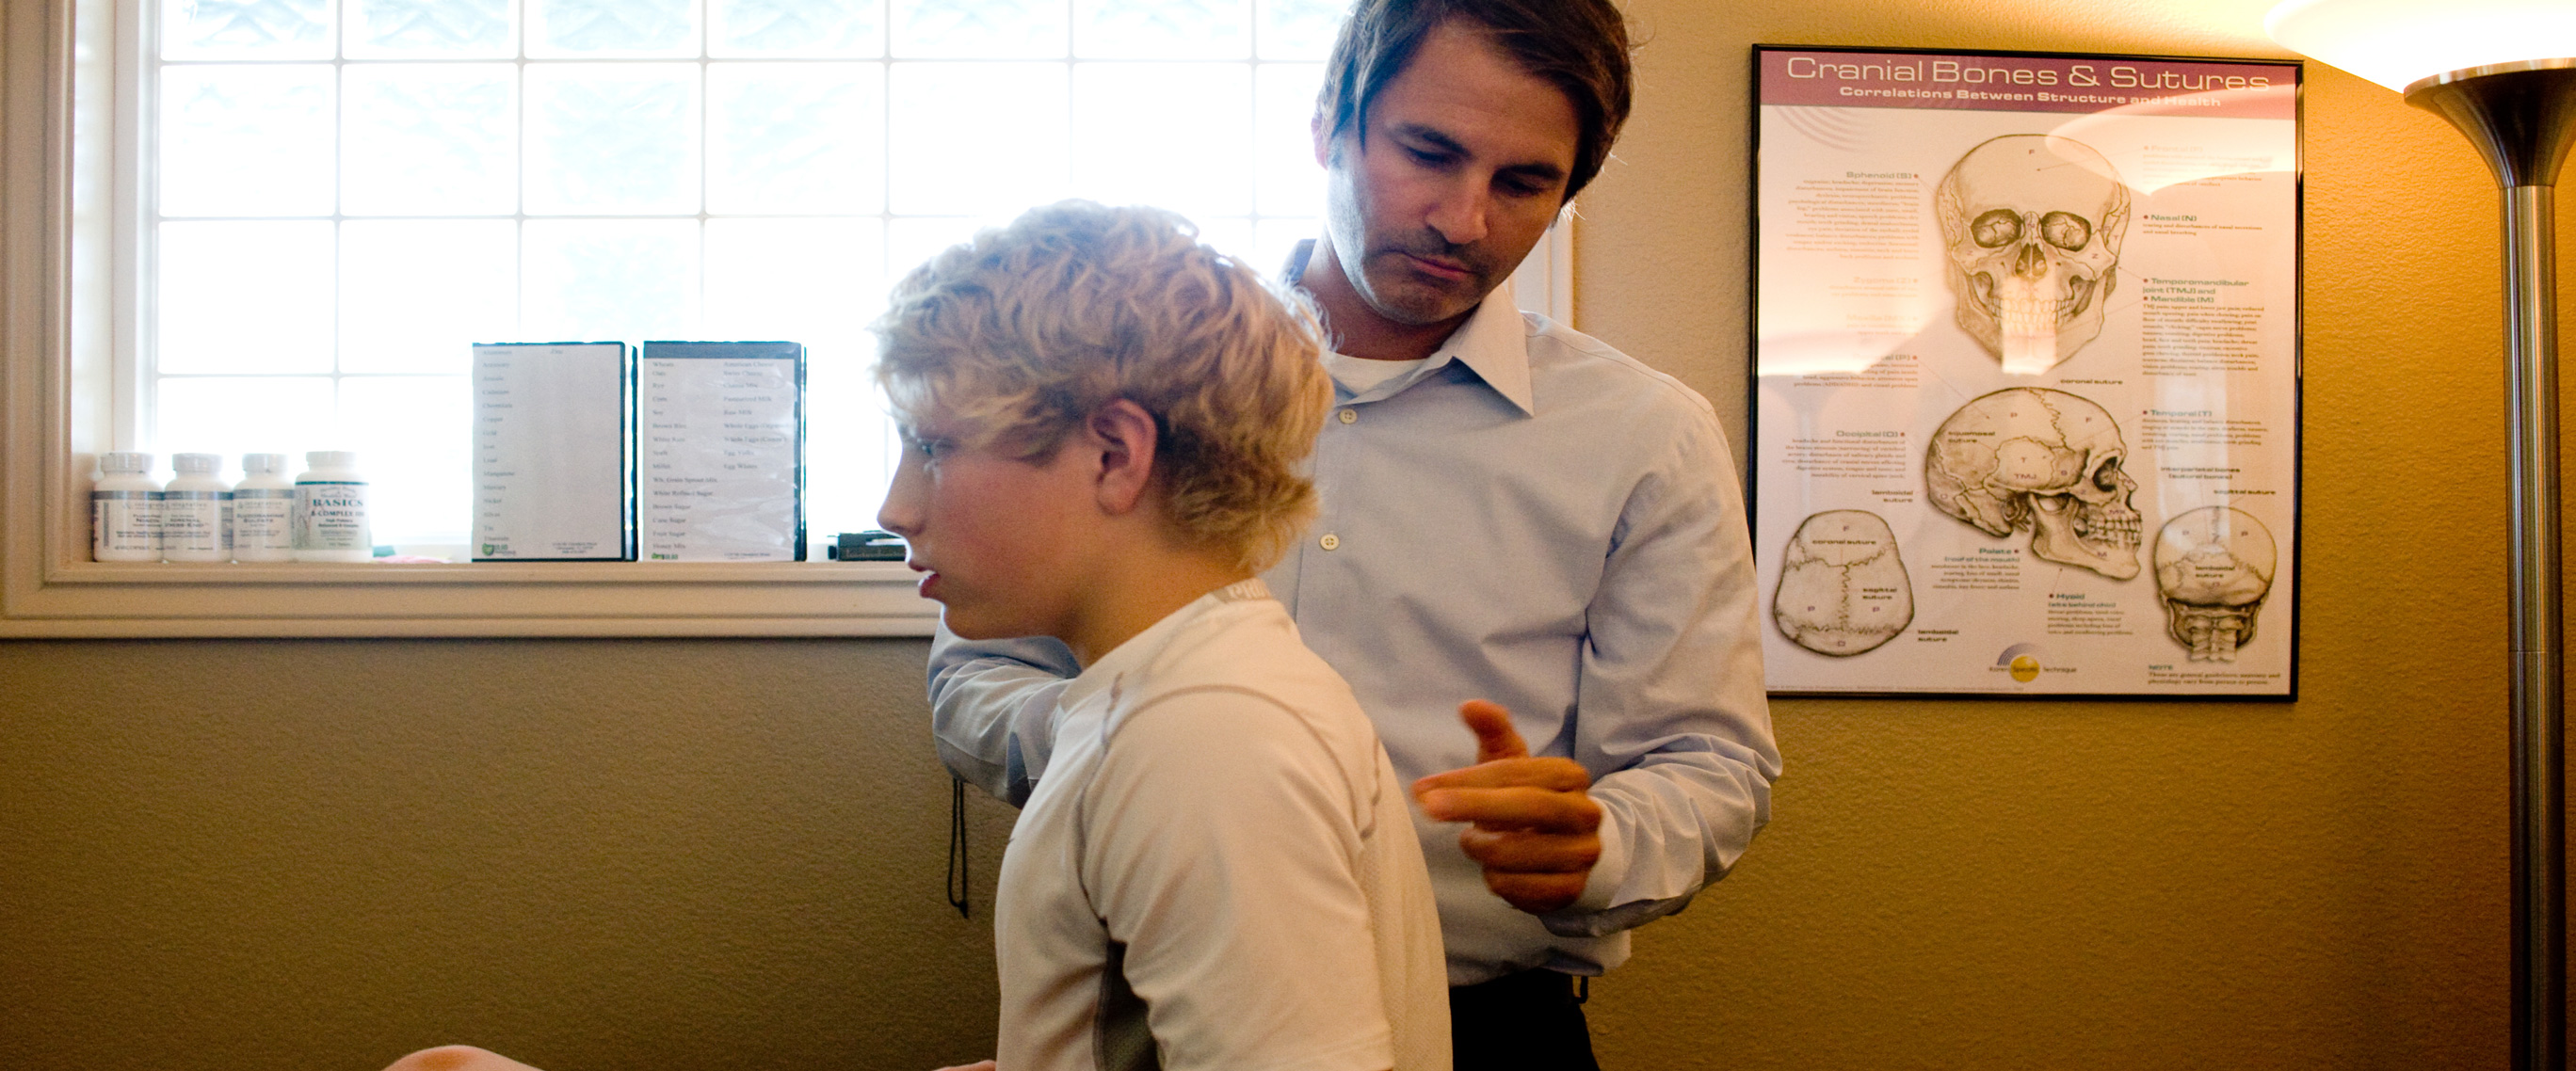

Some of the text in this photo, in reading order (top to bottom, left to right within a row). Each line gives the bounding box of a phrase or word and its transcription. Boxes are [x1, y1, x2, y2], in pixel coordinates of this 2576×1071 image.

[1787, 57, 2270, 91] Cranial Bones & Sutures
[1839, 86, 2222, 107] Correlations Between Structure and Health
